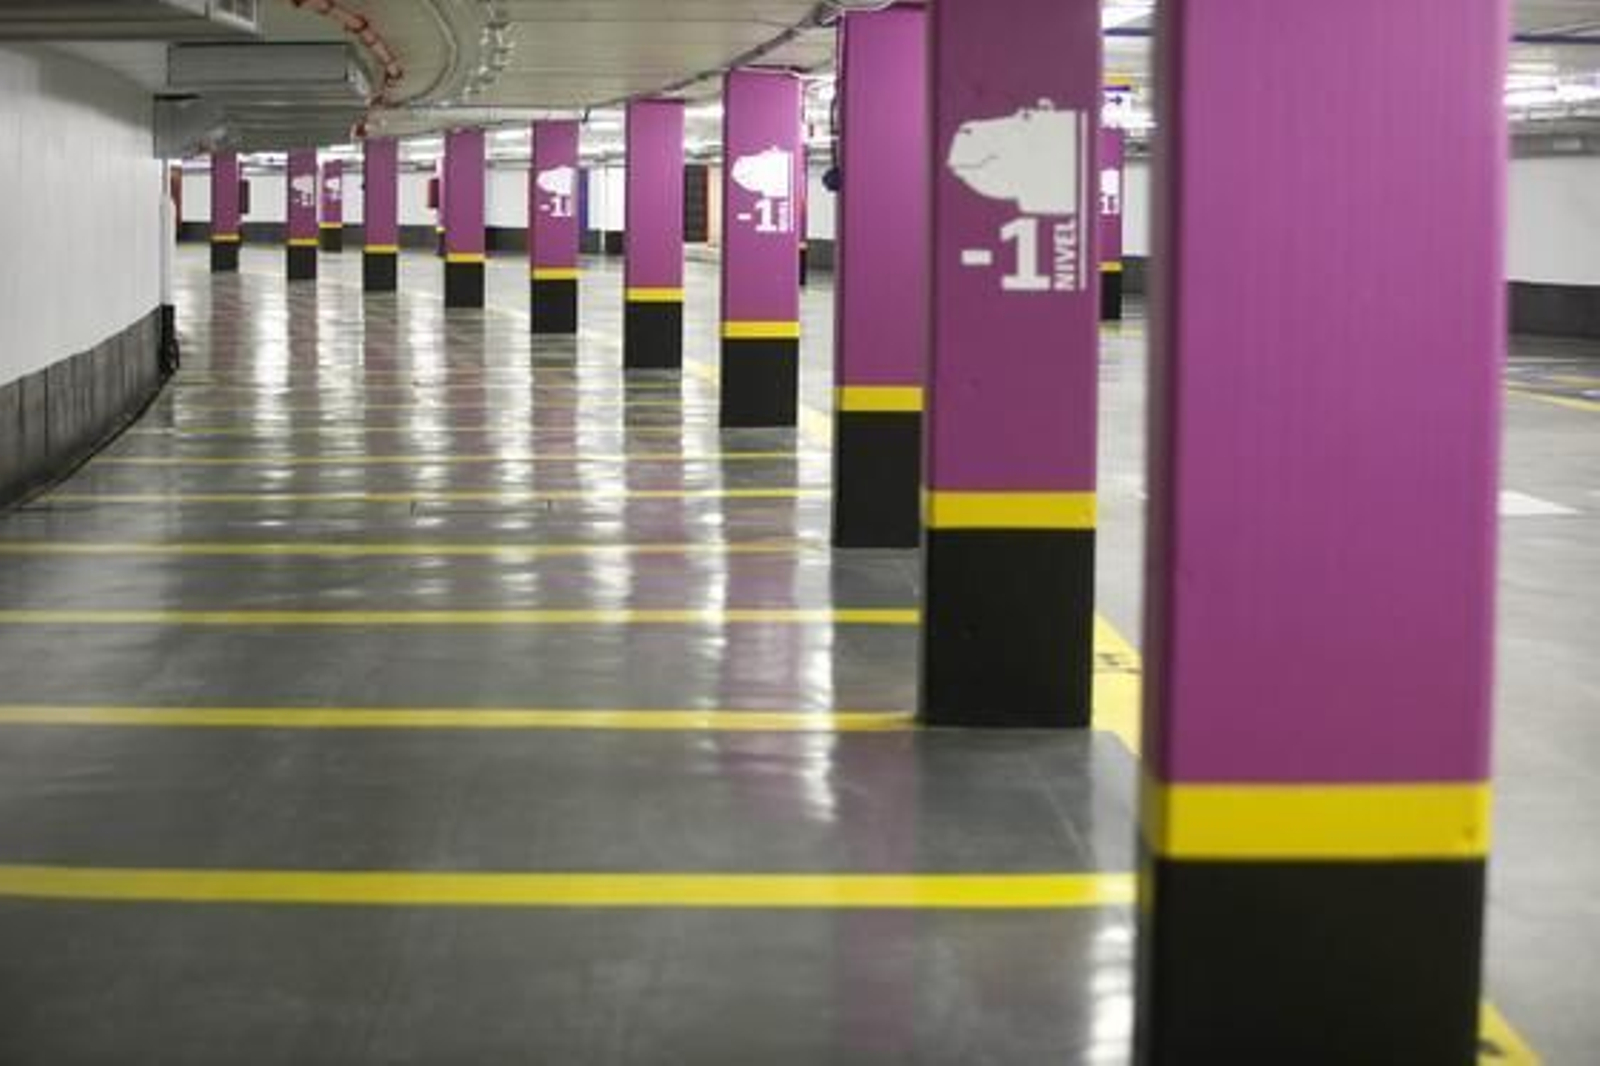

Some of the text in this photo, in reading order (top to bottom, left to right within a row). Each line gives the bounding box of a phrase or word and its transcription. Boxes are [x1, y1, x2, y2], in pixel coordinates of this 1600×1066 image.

[540, 198, 564, 217] -1
[737, 199, 777, 231] -1
[961, 218, 1050, 290] -1
[1053, 219, 1076, 290] NIVEL
